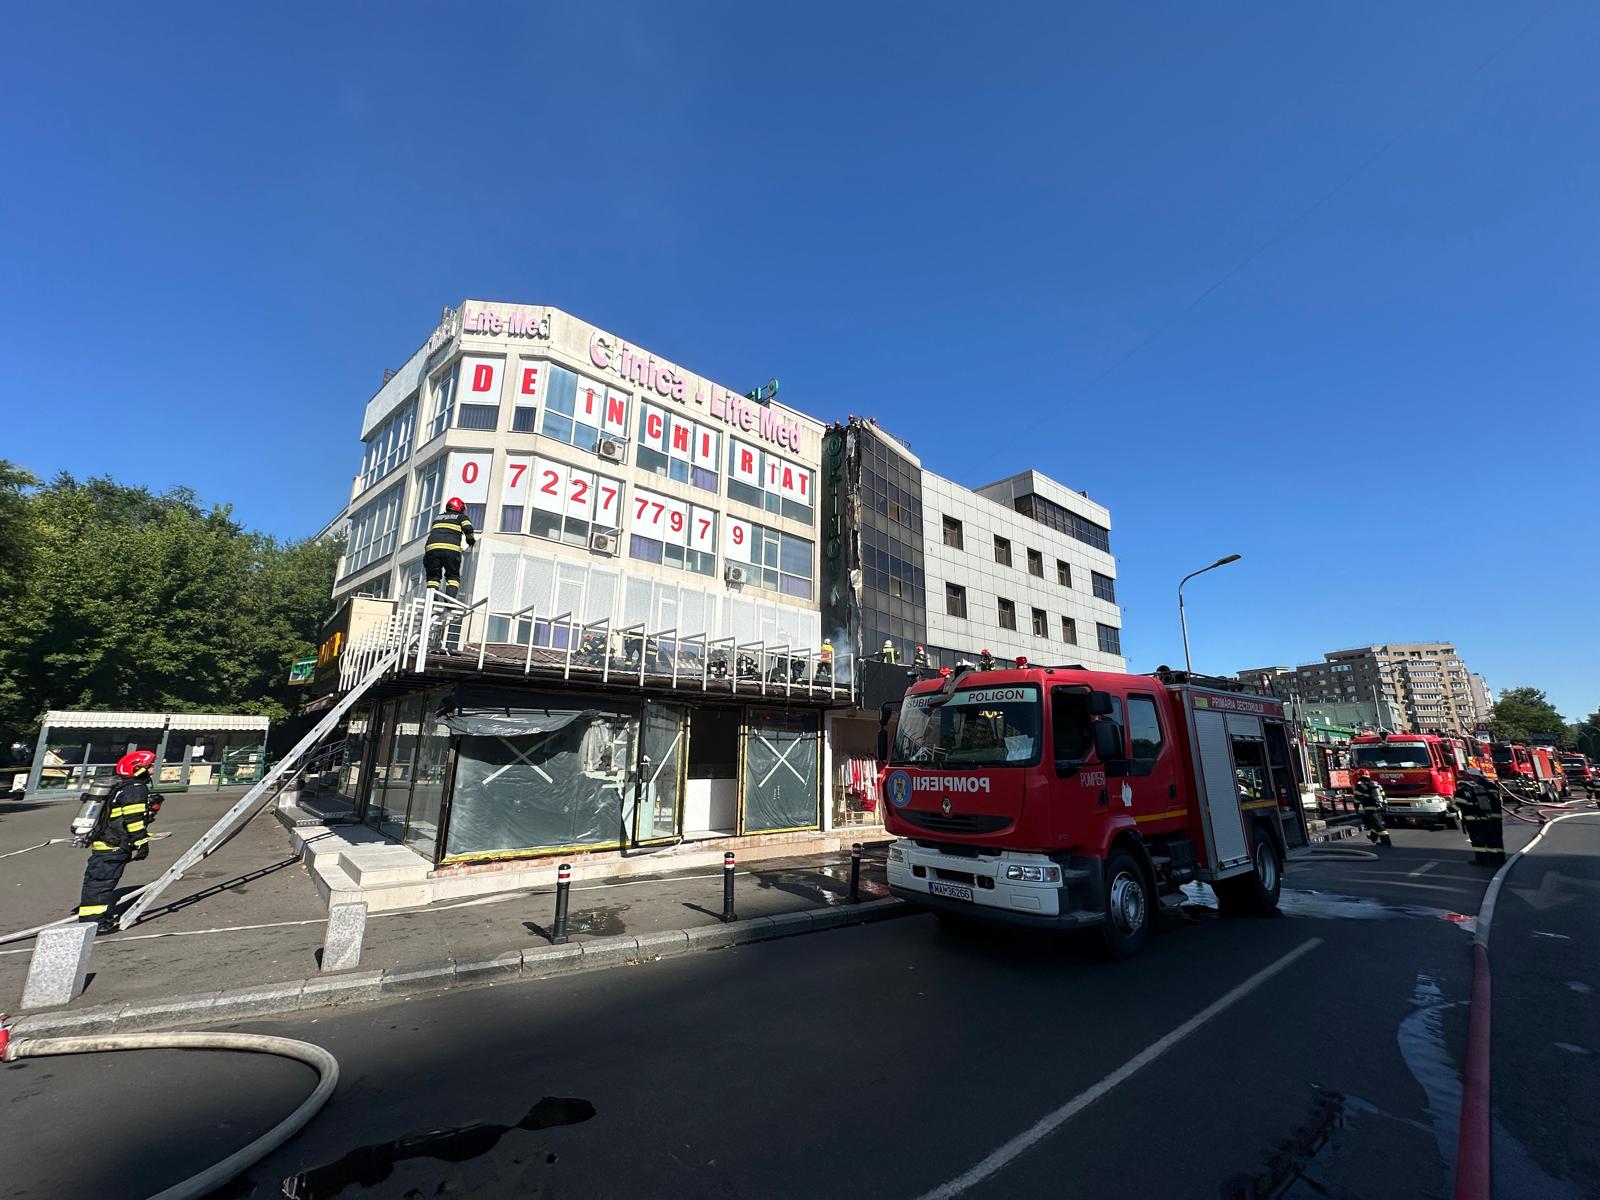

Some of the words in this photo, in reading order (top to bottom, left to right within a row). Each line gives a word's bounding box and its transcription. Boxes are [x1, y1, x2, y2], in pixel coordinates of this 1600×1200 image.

[463, 309, 503, 337] Life
[508, 311, 550, 340] Med
[472, 364, 538, 395] DE
[590, 331, 689, 404] Clinica
[709, 383, 752, 432] Life
[759, 406, 801, 453] Med
[968, 690, 1025, 702] POLIGON
